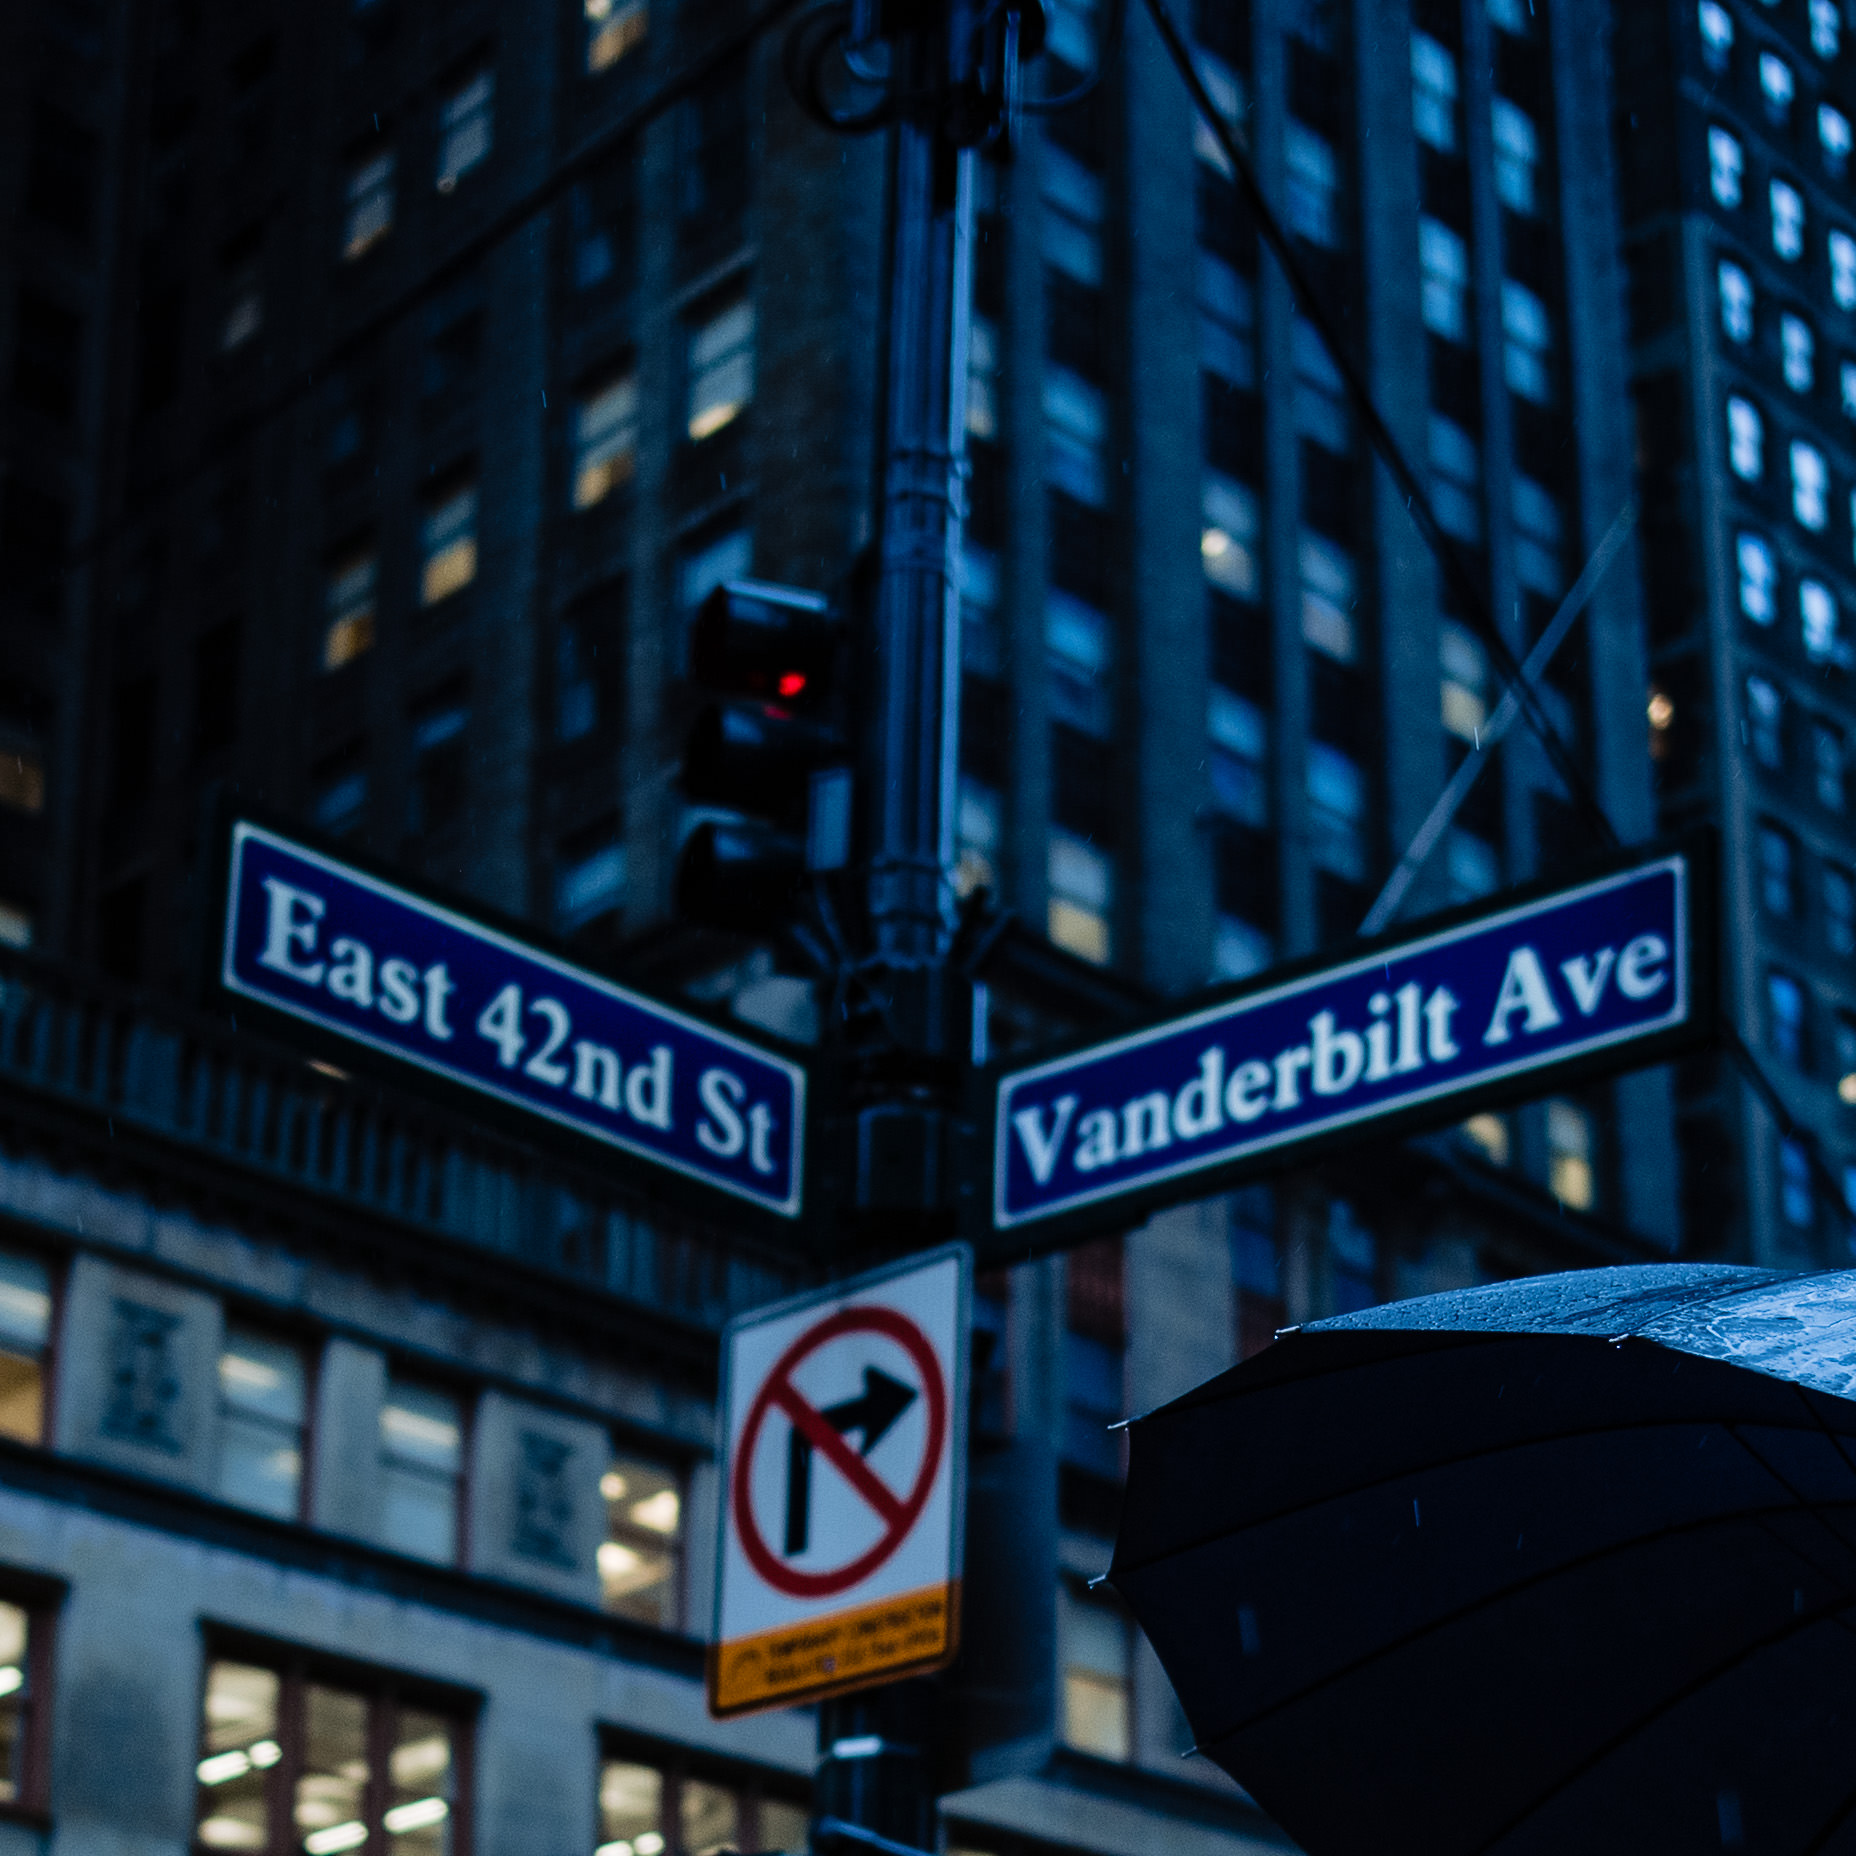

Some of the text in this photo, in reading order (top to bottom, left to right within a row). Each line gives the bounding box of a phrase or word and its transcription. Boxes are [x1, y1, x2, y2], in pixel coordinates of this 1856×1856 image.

[259, 876, 776, 1175] East 42nd St
[1013, 934, 1669, 1186] Vanderbilt Ave
